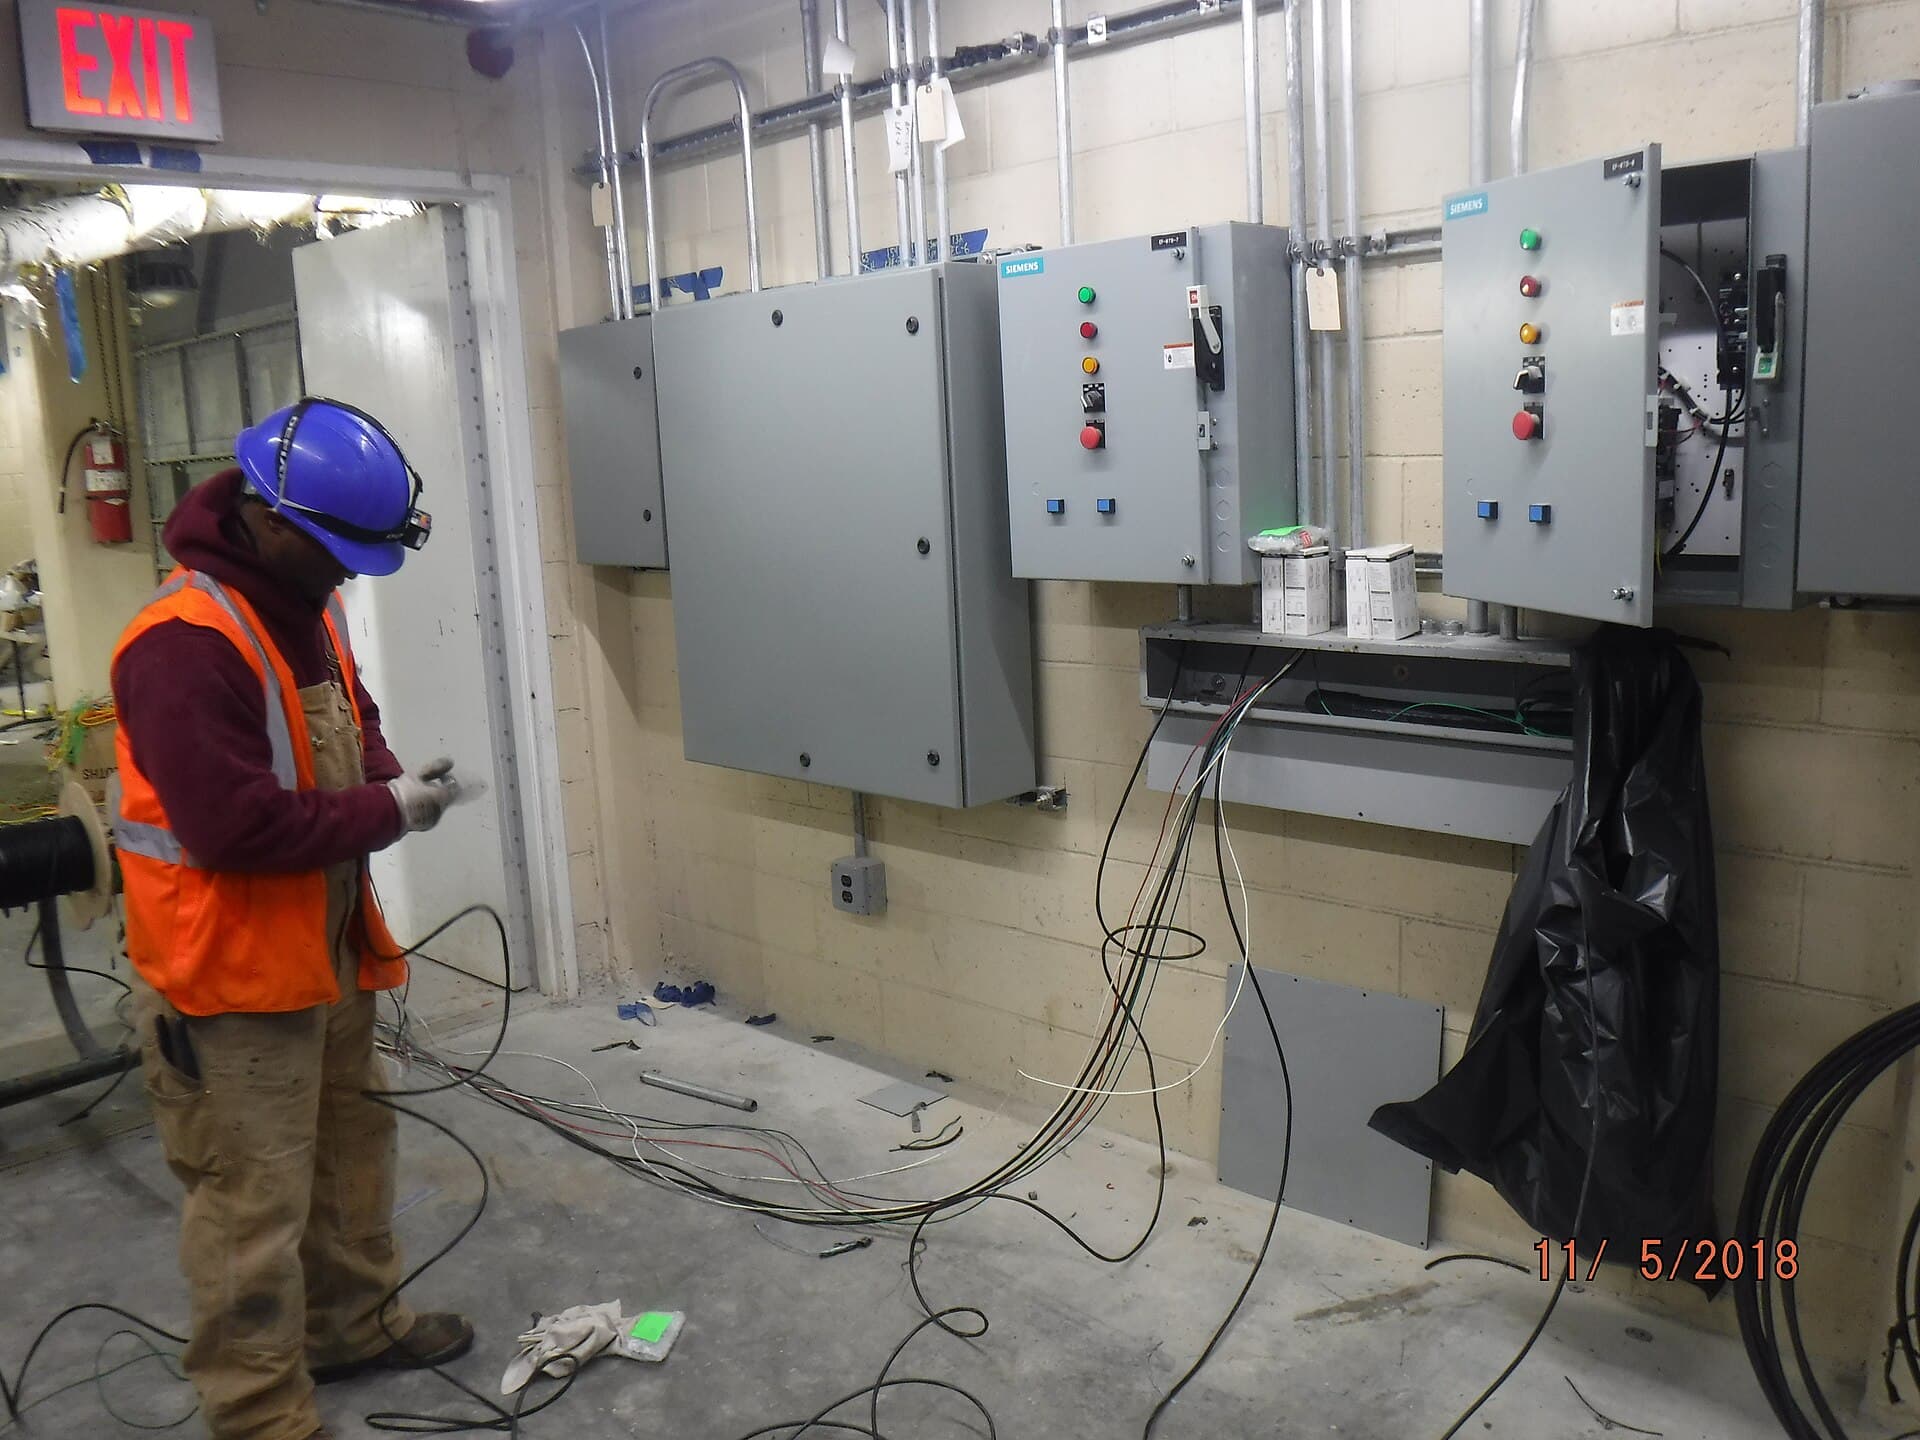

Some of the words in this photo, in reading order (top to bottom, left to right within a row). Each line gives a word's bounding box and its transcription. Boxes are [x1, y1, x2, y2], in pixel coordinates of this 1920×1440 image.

[56, 7, 193, 124] EXIT
[1450, 198, 1483, 215] SIEMENS
[1005, 261, 1039, 275] SIEMENS
